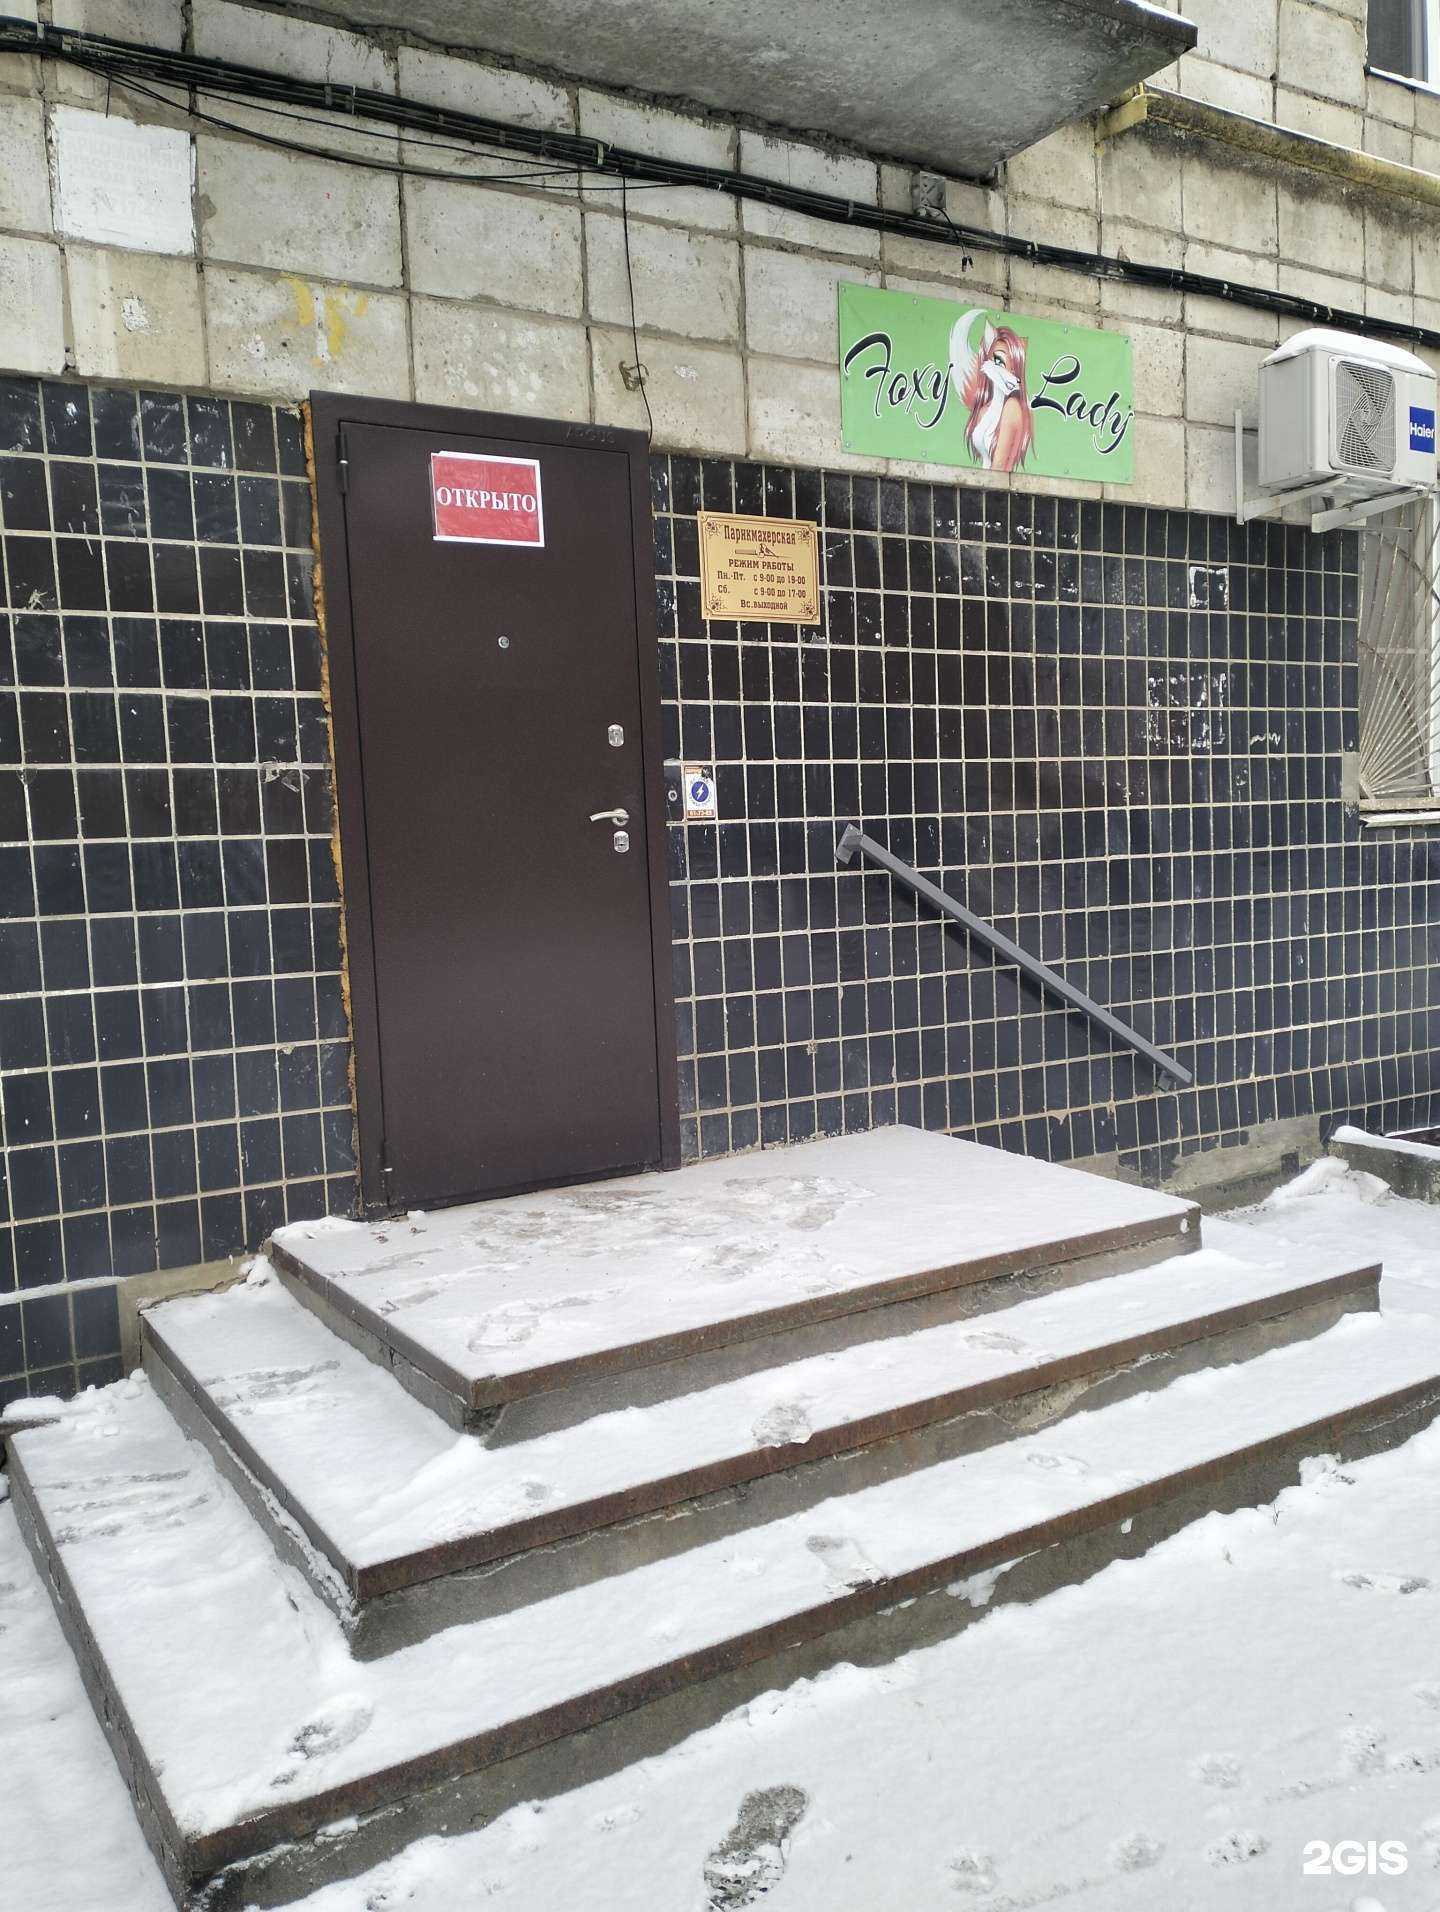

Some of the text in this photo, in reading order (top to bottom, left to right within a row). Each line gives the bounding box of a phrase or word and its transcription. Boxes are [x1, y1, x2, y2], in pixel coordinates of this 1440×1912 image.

[844, 332, 1135, 455] Foxy Lady
[1410, 422, 1434, 439] Haier
[436, 486, 537, 513] ОТКРЫТО
[724, 525, 796, 546] Парикмахерская
[728, 558, 794, 571] РЕЖИМ РАБОТЫ
[760, 573, 775, 582] 9-00
[788, 575, 805, 584] 19-00
[717, 584, 730, 593] Сб.
[760, 587, 775, 596] 9-00
[788, 589, 806, 598] 17-00
